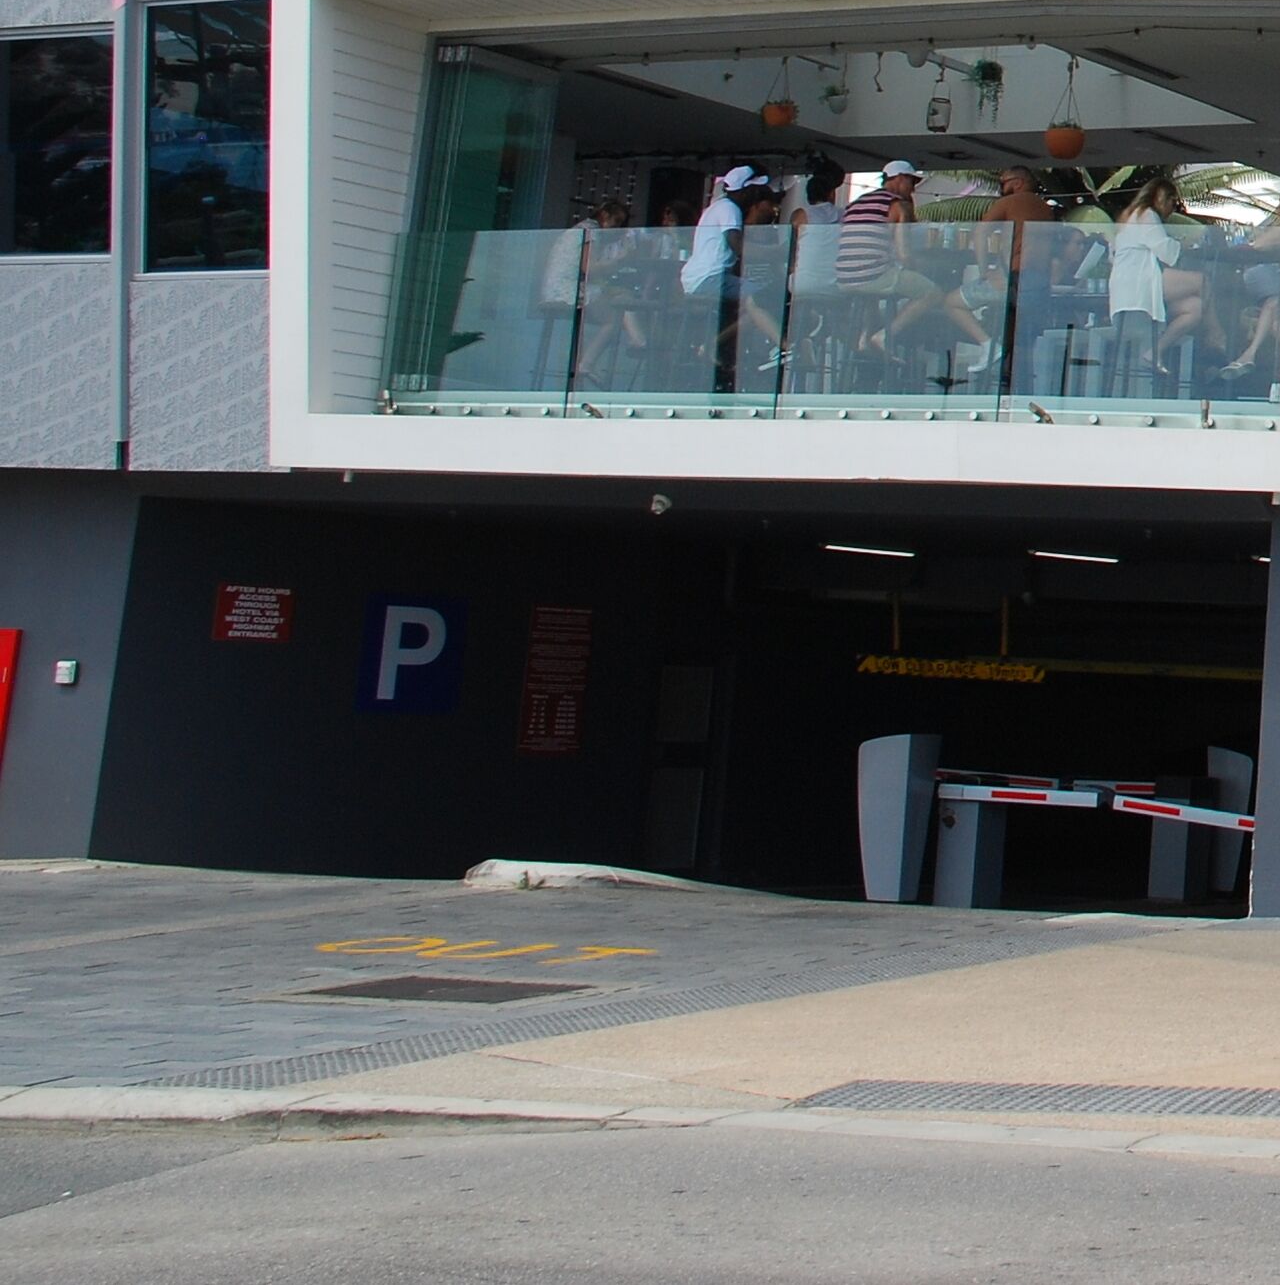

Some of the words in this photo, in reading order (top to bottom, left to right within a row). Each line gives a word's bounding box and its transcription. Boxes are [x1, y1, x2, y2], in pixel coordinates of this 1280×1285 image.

[226, 585, 256, 593] AFTER
[257, 587, 291, 595] HOURS
[238, 594, 277, 602] ACCESS
[234, 601, 280, 609] THROUGH
[231, 608, 262, 616] HOTEL
[224, 615, 251, 623] WEST
[228, 630, 279, 639] ENTRANCE
[377, 605, 447, 700] P
[875, 658, 900, 671] LOW
[905, 659, 977, 676] CLEARANCE
[315, 936, 658, 964] OUT
